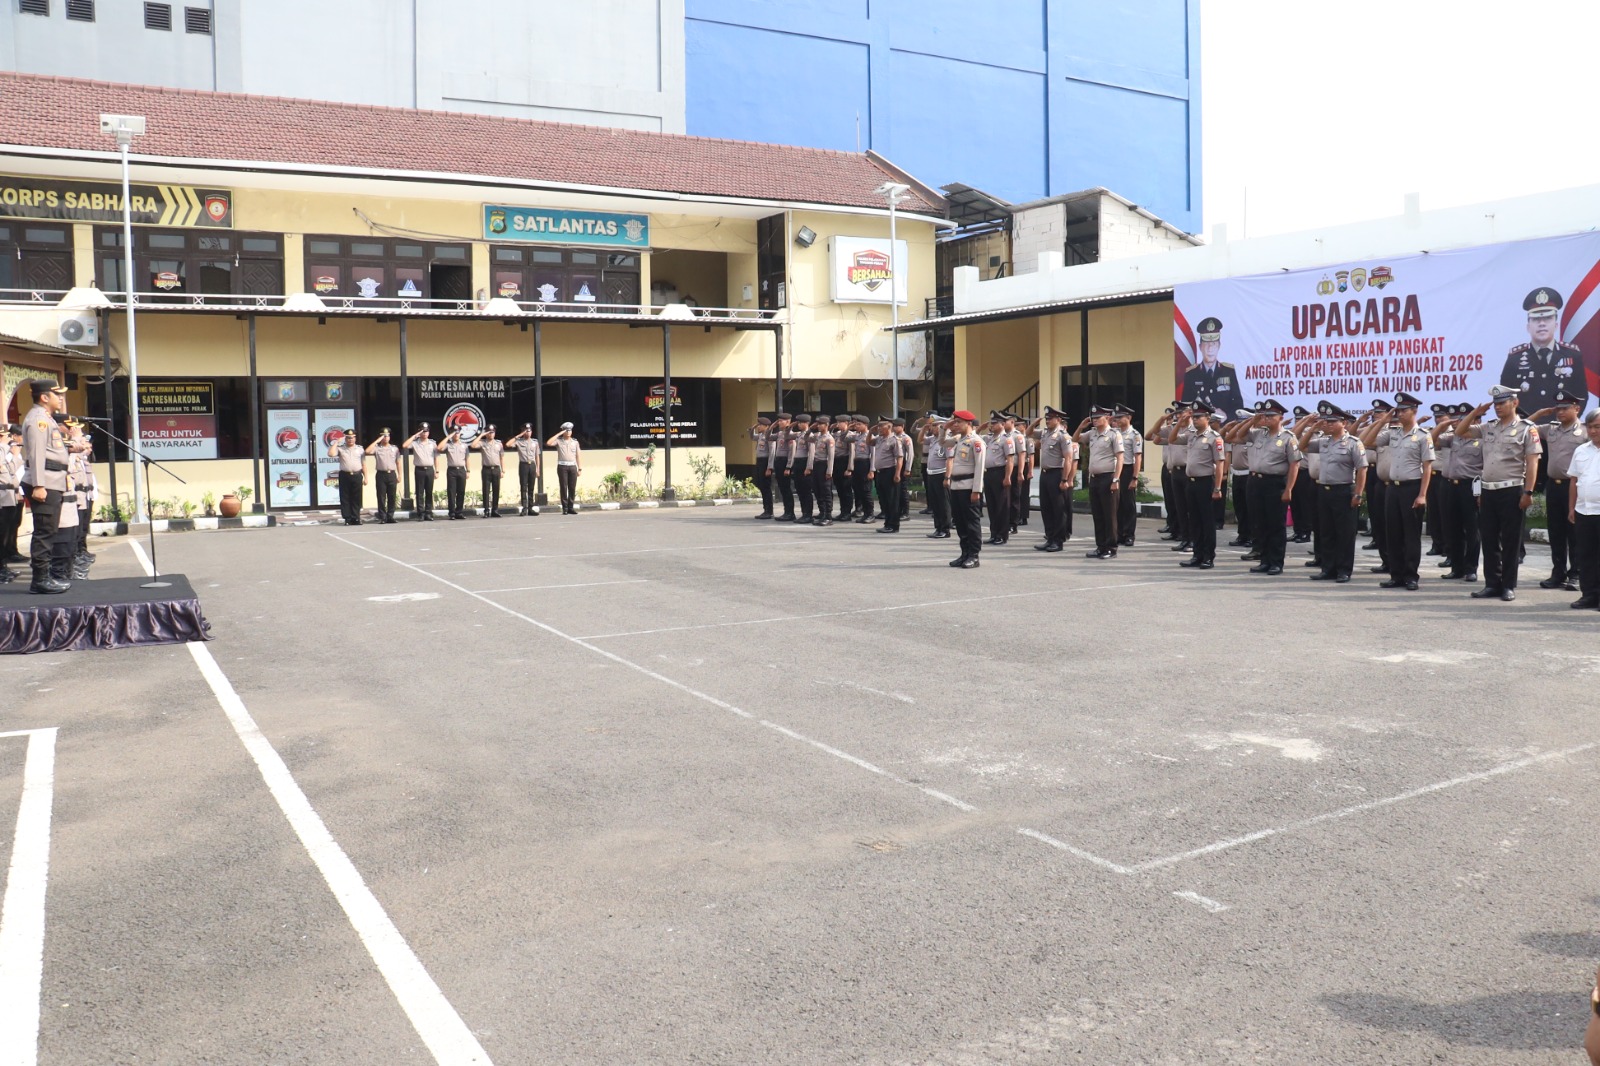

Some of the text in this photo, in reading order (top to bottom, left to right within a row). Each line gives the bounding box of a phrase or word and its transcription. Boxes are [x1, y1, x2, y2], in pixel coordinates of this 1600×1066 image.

[64, 191, 158, 213] SABHARA
[513, 215, 618, 236] SATLANTAS
[1292, 294, 1422, 340] UPACARA
[1274, 336, 1445, 362] LAPORAN KENAIKAN PANGKAT
[1245, 354, 1483, 380] ANGGOTA POLRI PERIODE 1 JANUARI 2026
[421, 380, 505, 391] SATRESNARKOBA
[1256, 374, 1468, 396] POLRES PELABUHAN TANJUNG PERAK
[142, 394, 201, 404] SATRESNARKOBA
[444, 391, 474, 399] PELABUHAN
[488, 391, 505, 399] PERAK
[648, 396, 682, 408] BERSAJA
[141, 429, 203, 438] POLRI UNTUK
[141, 440, 203, 448] MASYARAKAT
